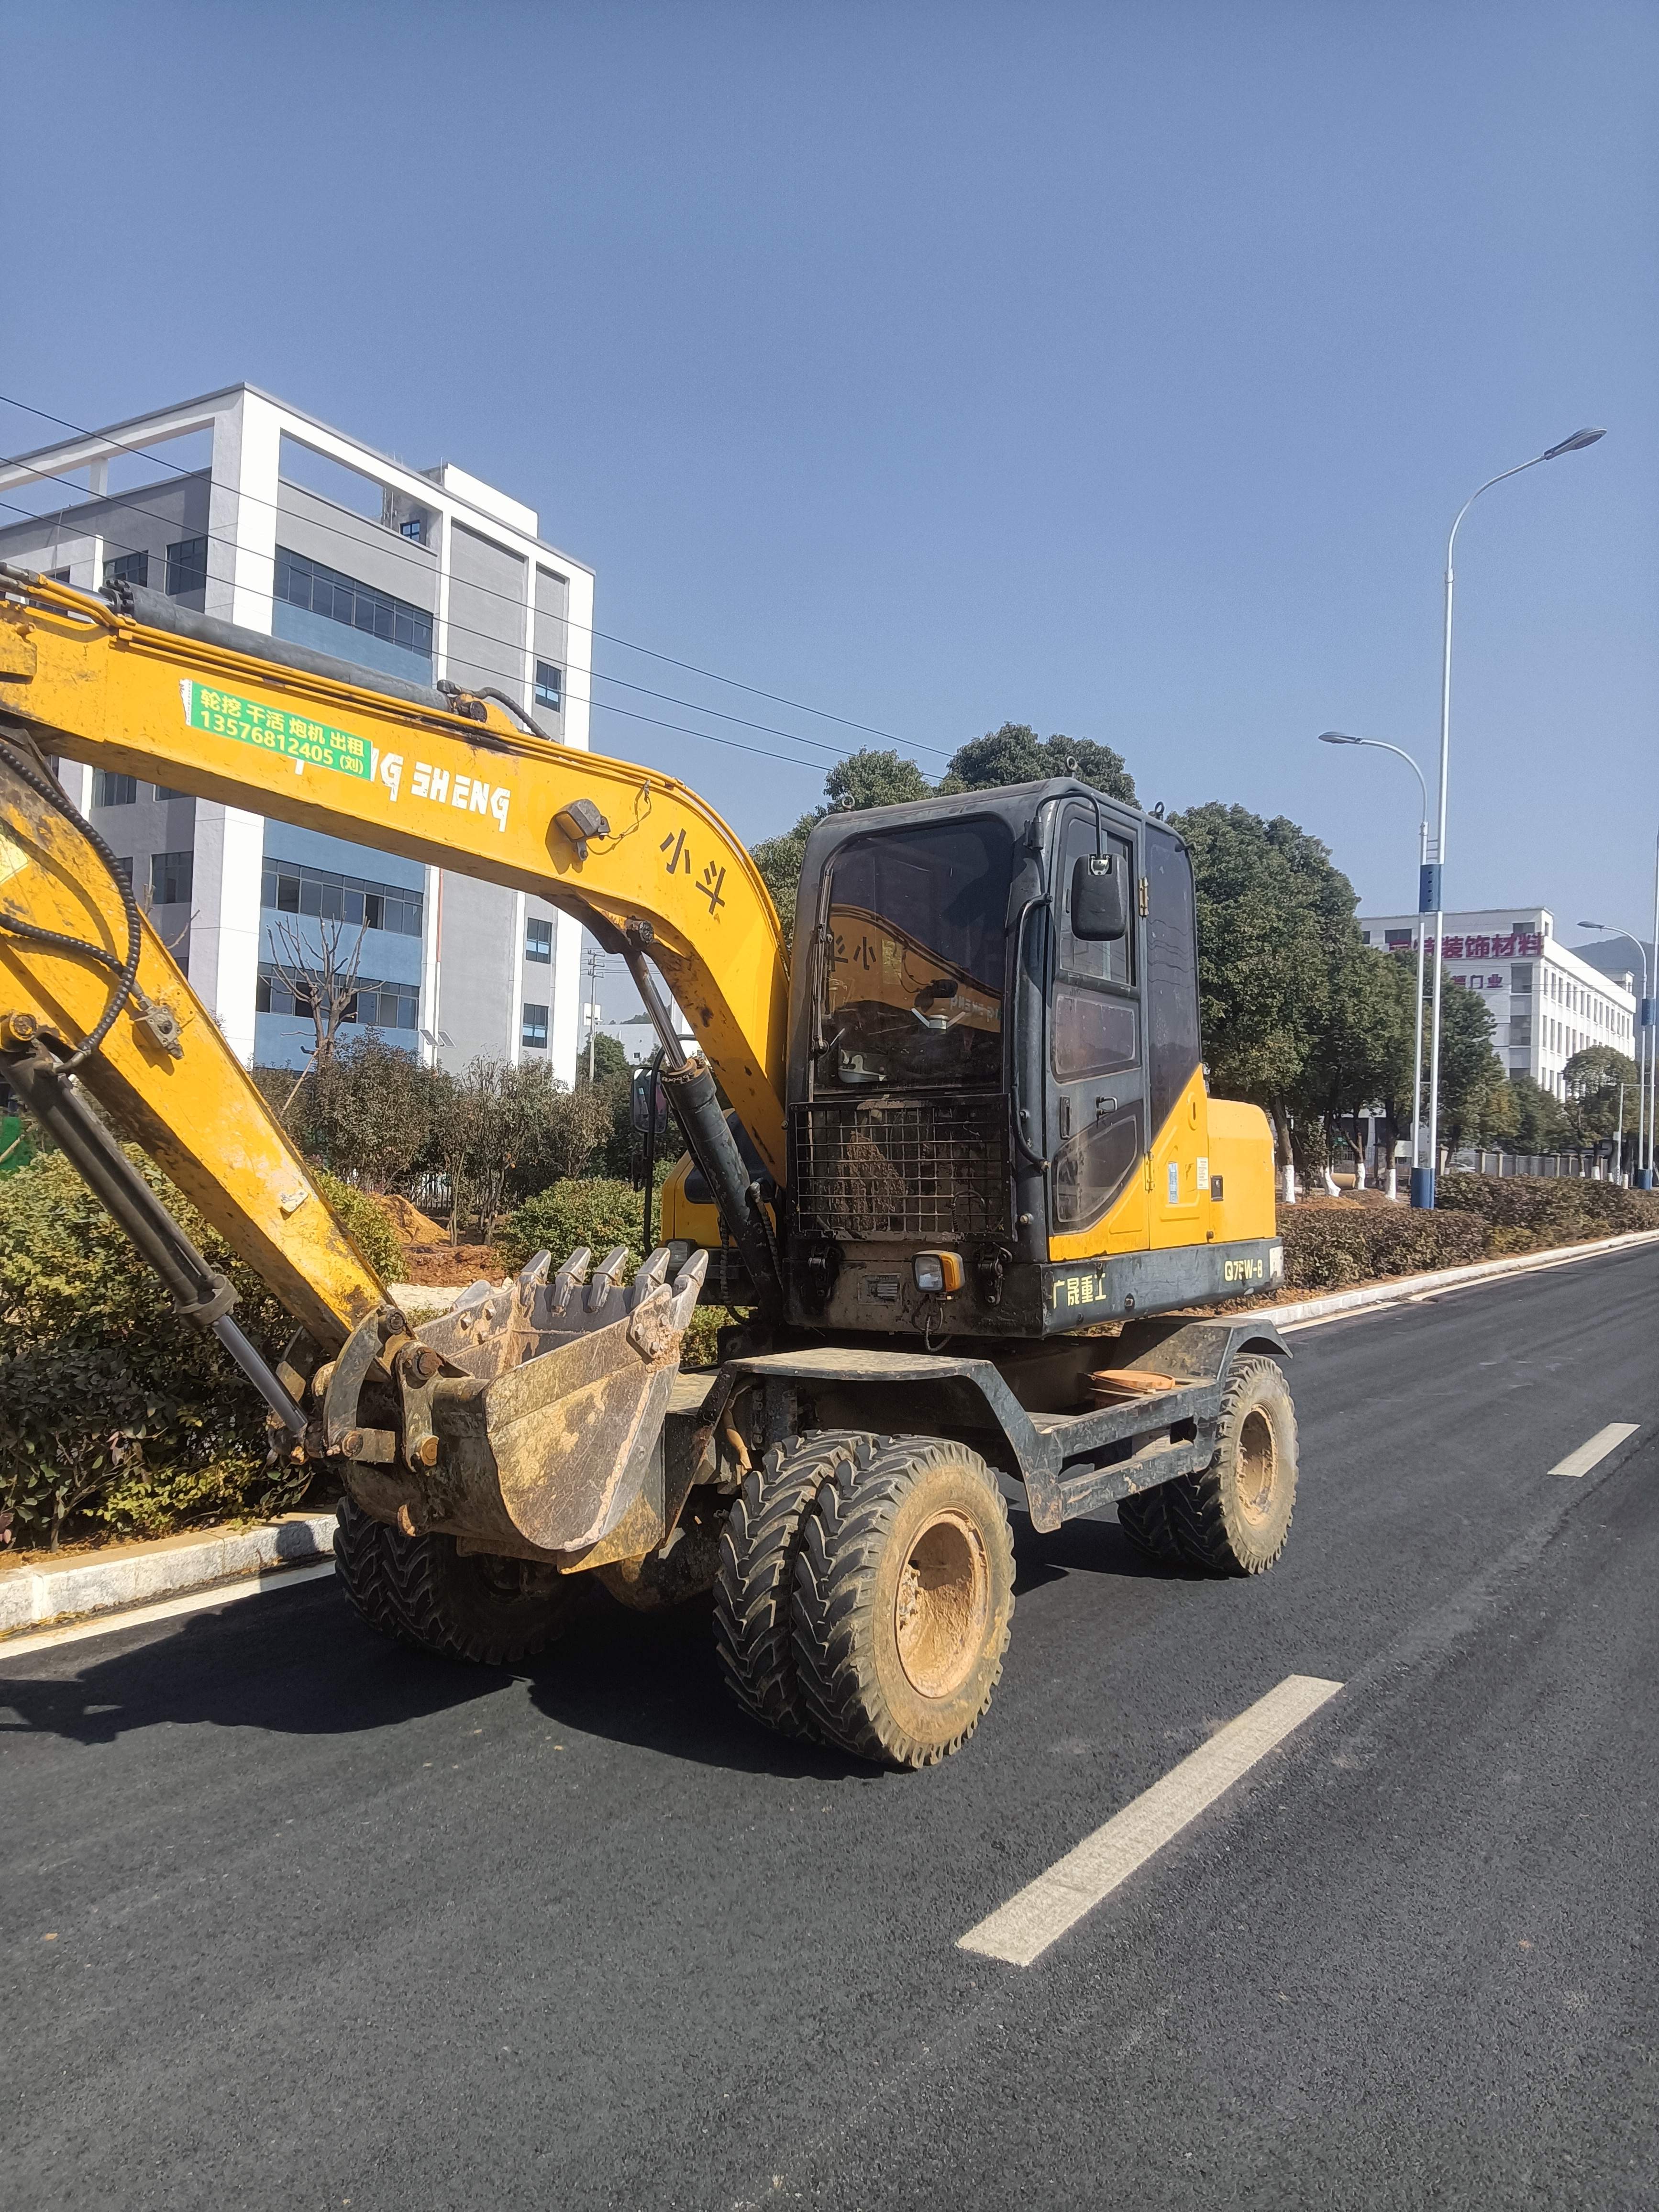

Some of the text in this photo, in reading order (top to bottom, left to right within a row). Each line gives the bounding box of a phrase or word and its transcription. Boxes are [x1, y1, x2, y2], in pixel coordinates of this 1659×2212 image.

[200, 688, 242, 718] 轮挖
[246, 704, 285, 732] 干活
[289, 717, 325, 745] 炮机
[330, 731, 365, 758] 出租
[200, 710, 364, 774] 13576812405 (刘)
[410, 761, 511, 832] SHENG
[659, 828, 726, 915] 小斗
[1053, 1273, 1106, 1309] 广晟重工
